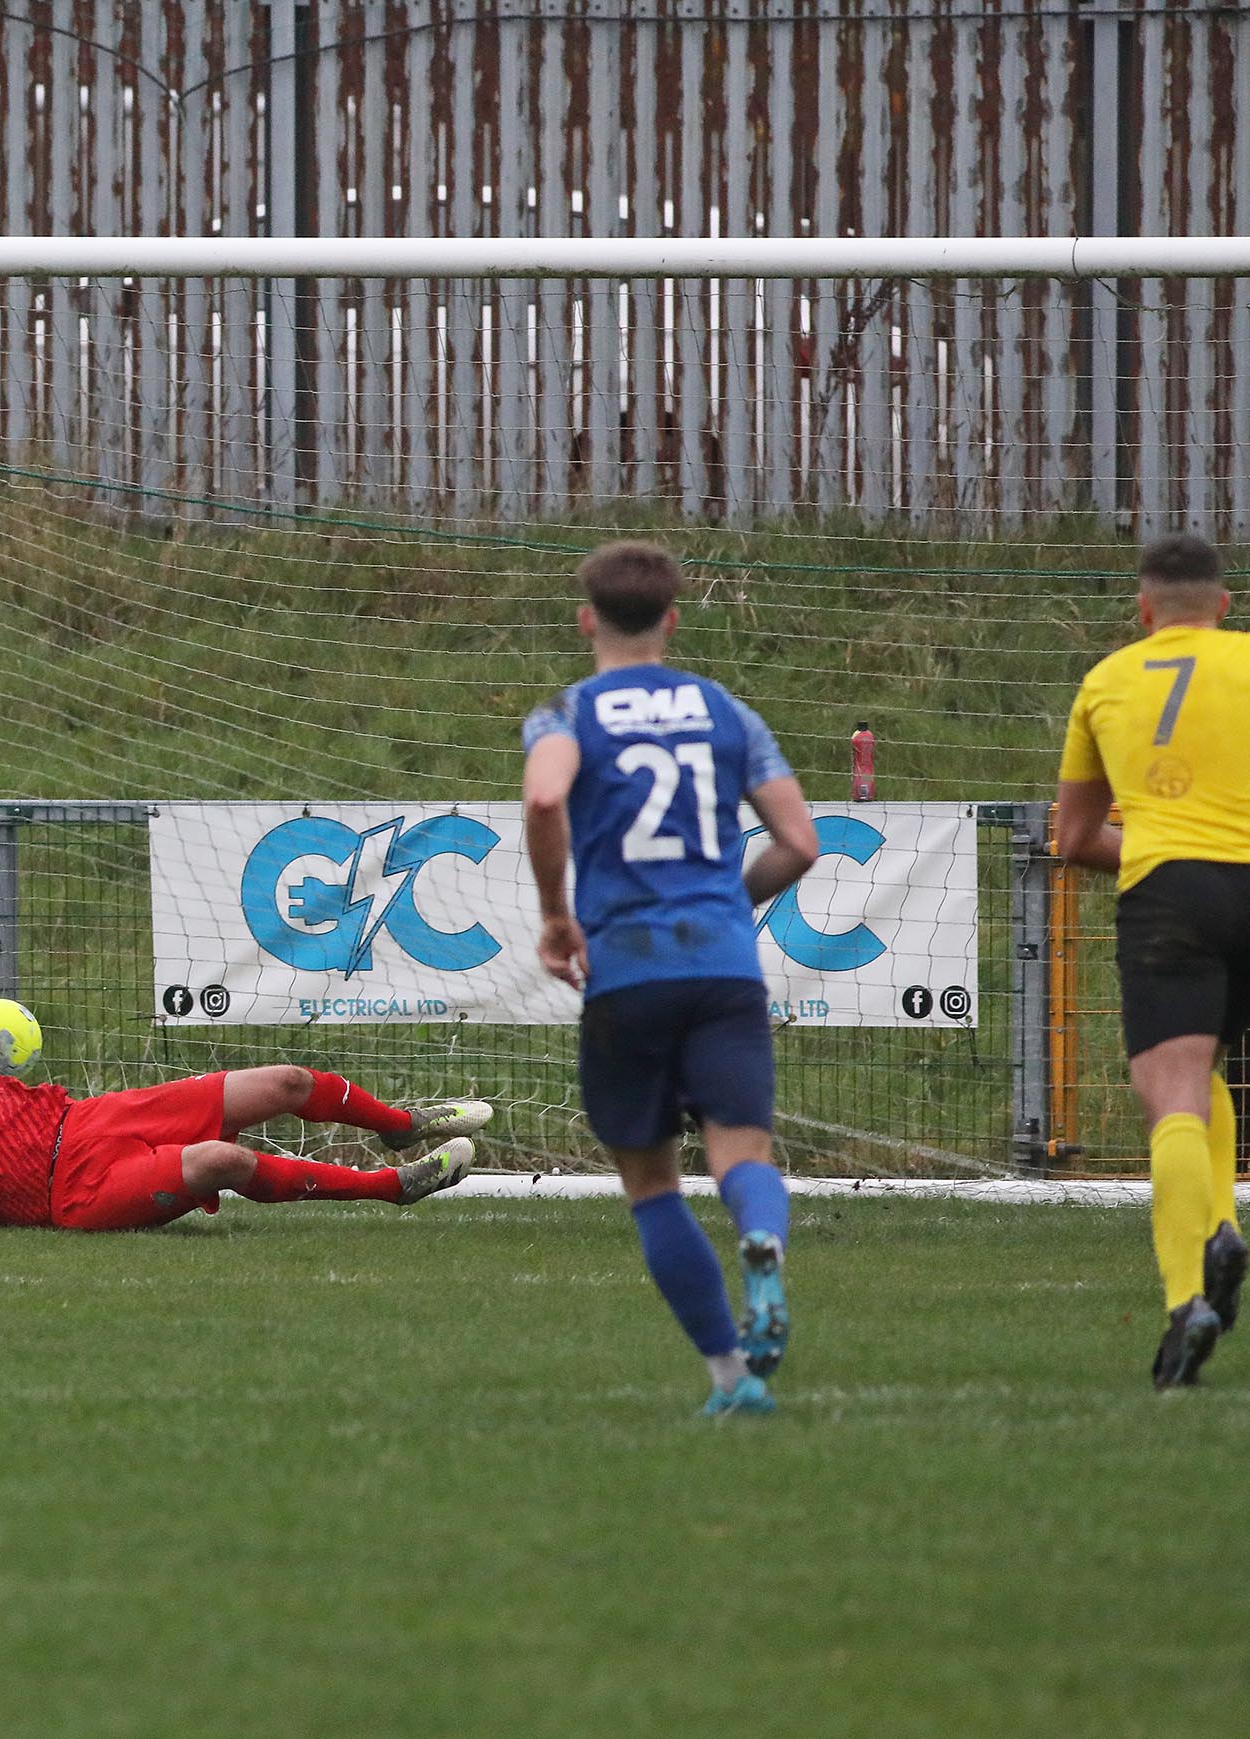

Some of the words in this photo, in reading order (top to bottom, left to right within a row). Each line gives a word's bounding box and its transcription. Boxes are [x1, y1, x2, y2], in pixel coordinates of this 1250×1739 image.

[1144, 656, 1196, 746] 7
[615, 742, 721, 862] 21
[300, 998, 413, 1017] ELECTRICAL
[417, 999, 447, 1016] LTD
[799, 999, 830, 1017] LTD
